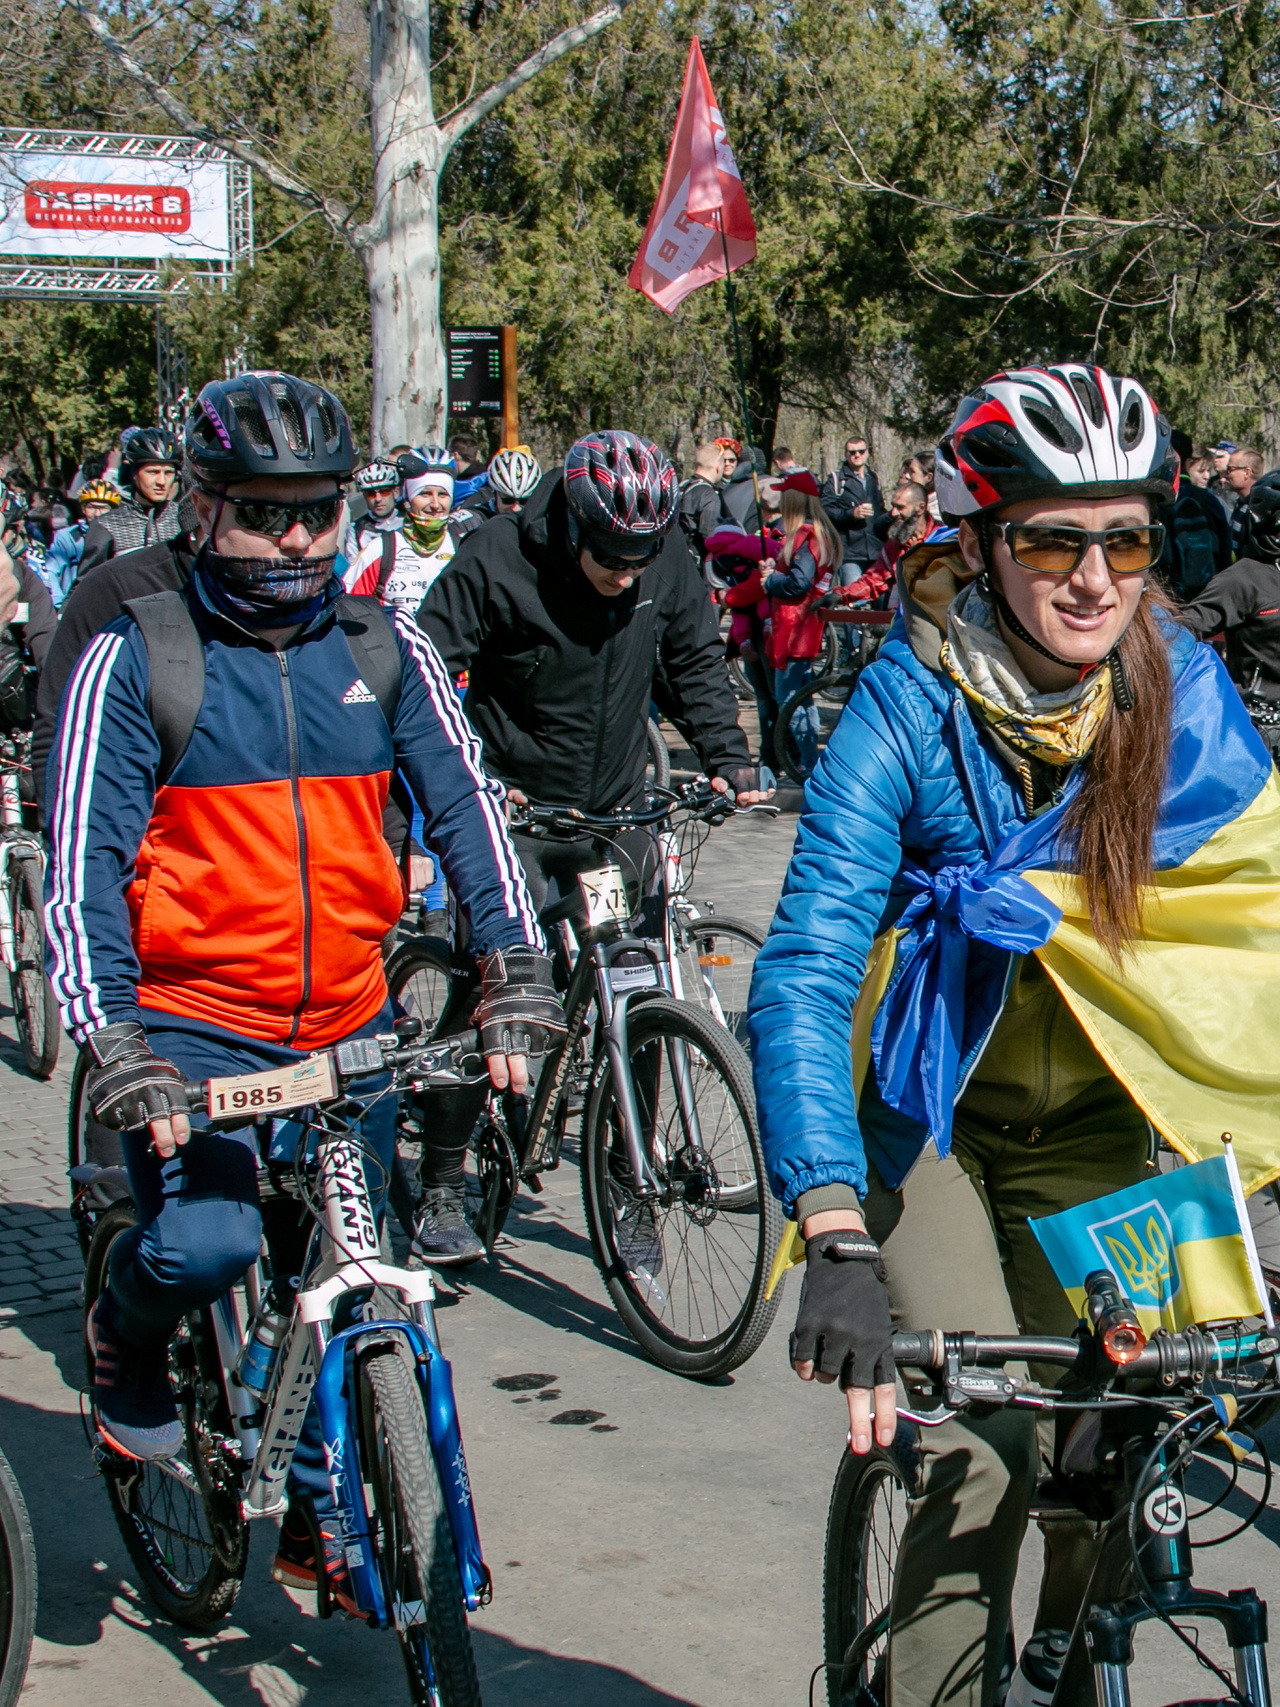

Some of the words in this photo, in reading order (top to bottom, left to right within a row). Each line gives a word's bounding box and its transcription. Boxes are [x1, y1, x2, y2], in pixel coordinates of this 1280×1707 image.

[36, 191, 154, 212] ТАВРИЯ
[162, 195, 183, 214] В
[411, 581, 428, 589] usg
[342, 694, 377, 704] adidas
[623, 966, 654, 976] SHIMA
[532, 1130, 549, 1163] 29
[543, 1002, 586, 1120] TOMAHAWK
[593, 1054, 610, 1089] KEN
[216, 1085, 283, 1111] 1985
